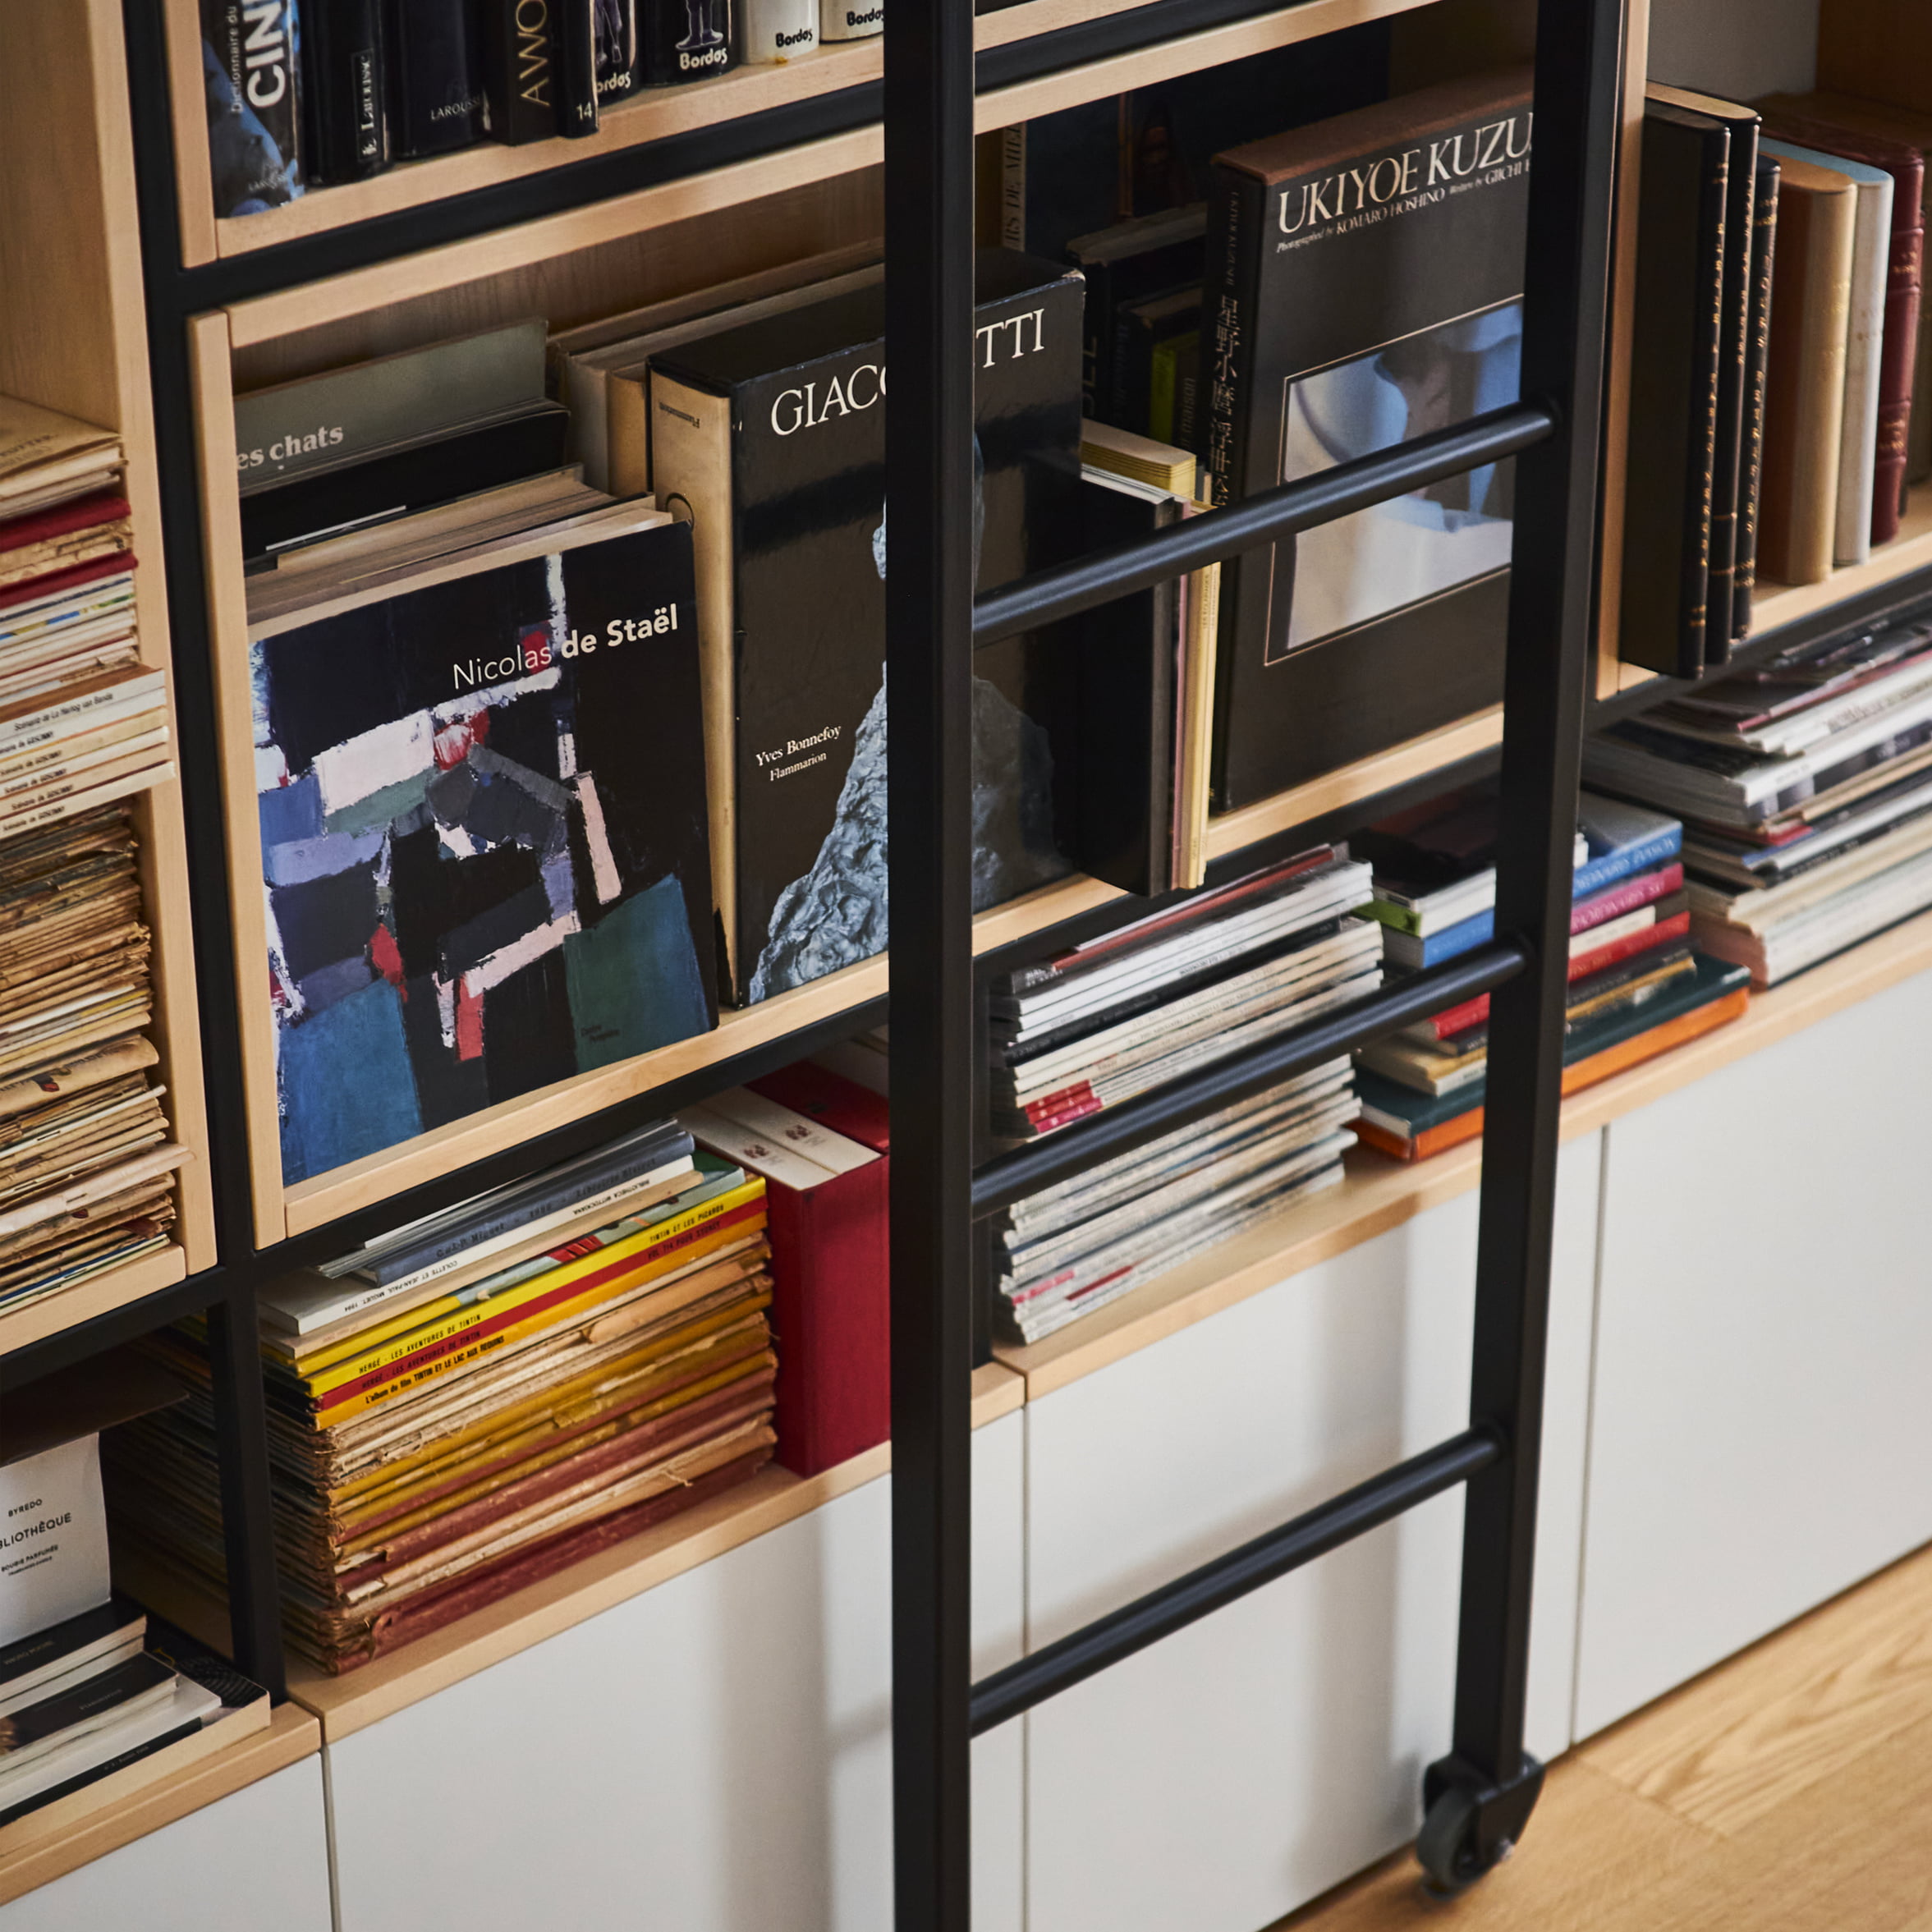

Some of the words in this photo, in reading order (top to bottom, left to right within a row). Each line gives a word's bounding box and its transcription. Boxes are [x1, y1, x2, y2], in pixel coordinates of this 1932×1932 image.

[227, 5, 238, 25] du
[241, 0, 286, 108] CIN
[775, 28, 813, 48] Bordas
[231, 27, 244, 113] Dictionnaire
[679, 46, 728, 71] Bordas
[576, 100, 593, 121] 14
[1278, 149, 1420, 234] UKIYOE
[1427, 111, 1534, 186] KUZU
[1335, 205, 1388, 235] KOMARO
[1390, 187, 1446, 218] HOSHINO
[268, 423, 345, 463] chats
[452, 643, 553, 691] Nicolas
[561, 629, 598, 660] de
[606, 603, 679, 649] Staël
[755, 747, 784, 767] Yves
[787, 725, 842, 755] Bonnefoy
[769, 751, 827, 782] Flammarion
[649, 1229, 670, 1244] TINTIN
[673, 1223, 681, 1232] ET
[683, 1218, 695, 1229] LES
[388, 1275, 421, 1293] JEAN-PAUL
[421, 1272, 430, 1280] ET
[432, 1260, 458, 1275] COLETTE
[359, 1357, 382, 1374] HERGÉ
[391, 1348, 403, 1361] LES
[406, 1330, 445, 1353] AVENTURES
[447, 1326, 457, 1335] DE
[459, 1314, 482, 1330] TINTIN
[361, 1373, 383, 1390] HERGÉ
[392, 1363, 405, 1376] LES
[407, 1347, 446, 1369] AVENTURES
[448, 1340, 457, 1351] DE
[460, 1330, 482, 1346] TINTIN
[413, 1367, 434, 1382] TINTIN
[434, 1363, 443, 1374] ET
[443, 1358, 452, 1369] LE
[453, 1352, 466, 1365] LAC
[466, 1347, 479, 1359] AUX
[480, 1335, 506, 1353] REQUINS
[8, 1498, 43, 1518] BYREDO
